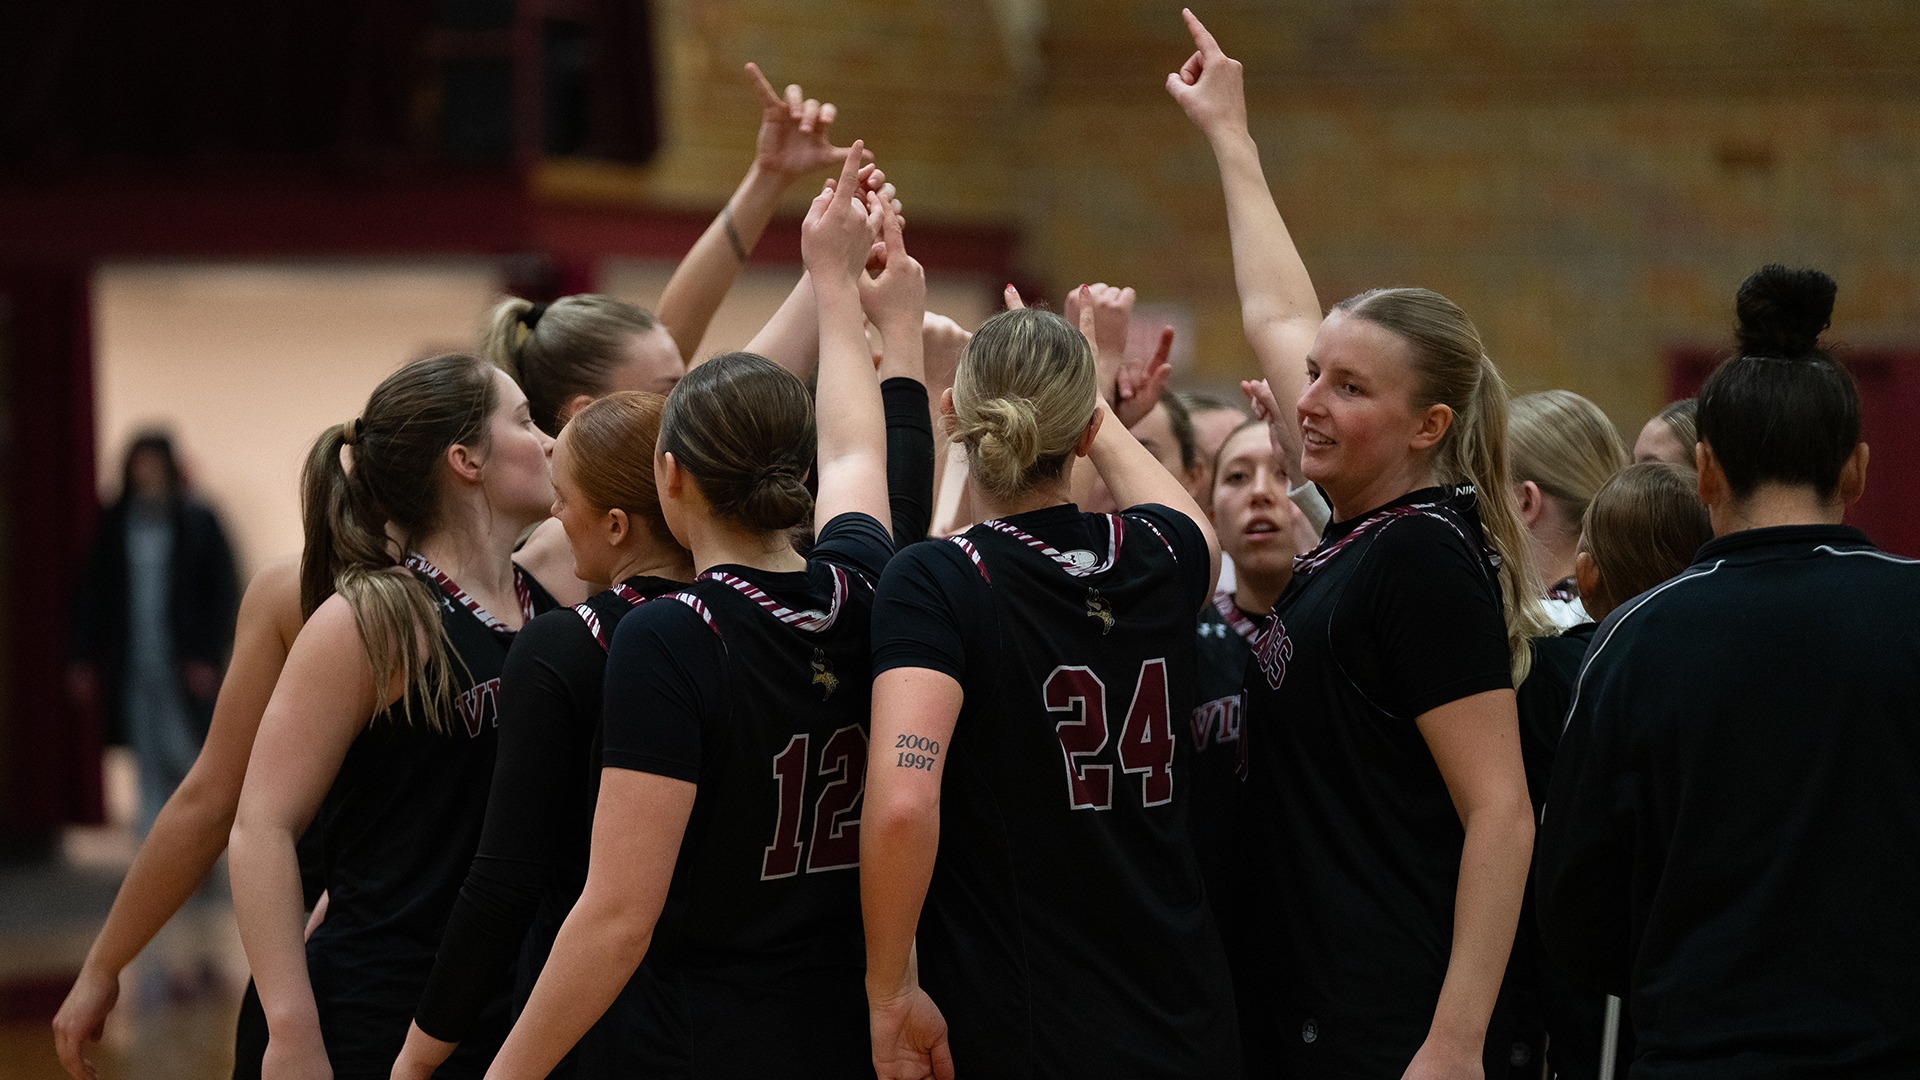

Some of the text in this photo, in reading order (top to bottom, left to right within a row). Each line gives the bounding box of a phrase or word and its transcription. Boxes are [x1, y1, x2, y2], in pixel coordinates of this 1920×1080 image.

[1455, 485, 1477, 497] NIK
[454, 677, 501, 739] VI
[1042, 657, 1175, 811] 24
[1190, 693, 1241, 753] VI
[894, 734, 940, 755] 2000
[896, 752, 935, 772] 1997
[760, 723, 869, 881] 12
